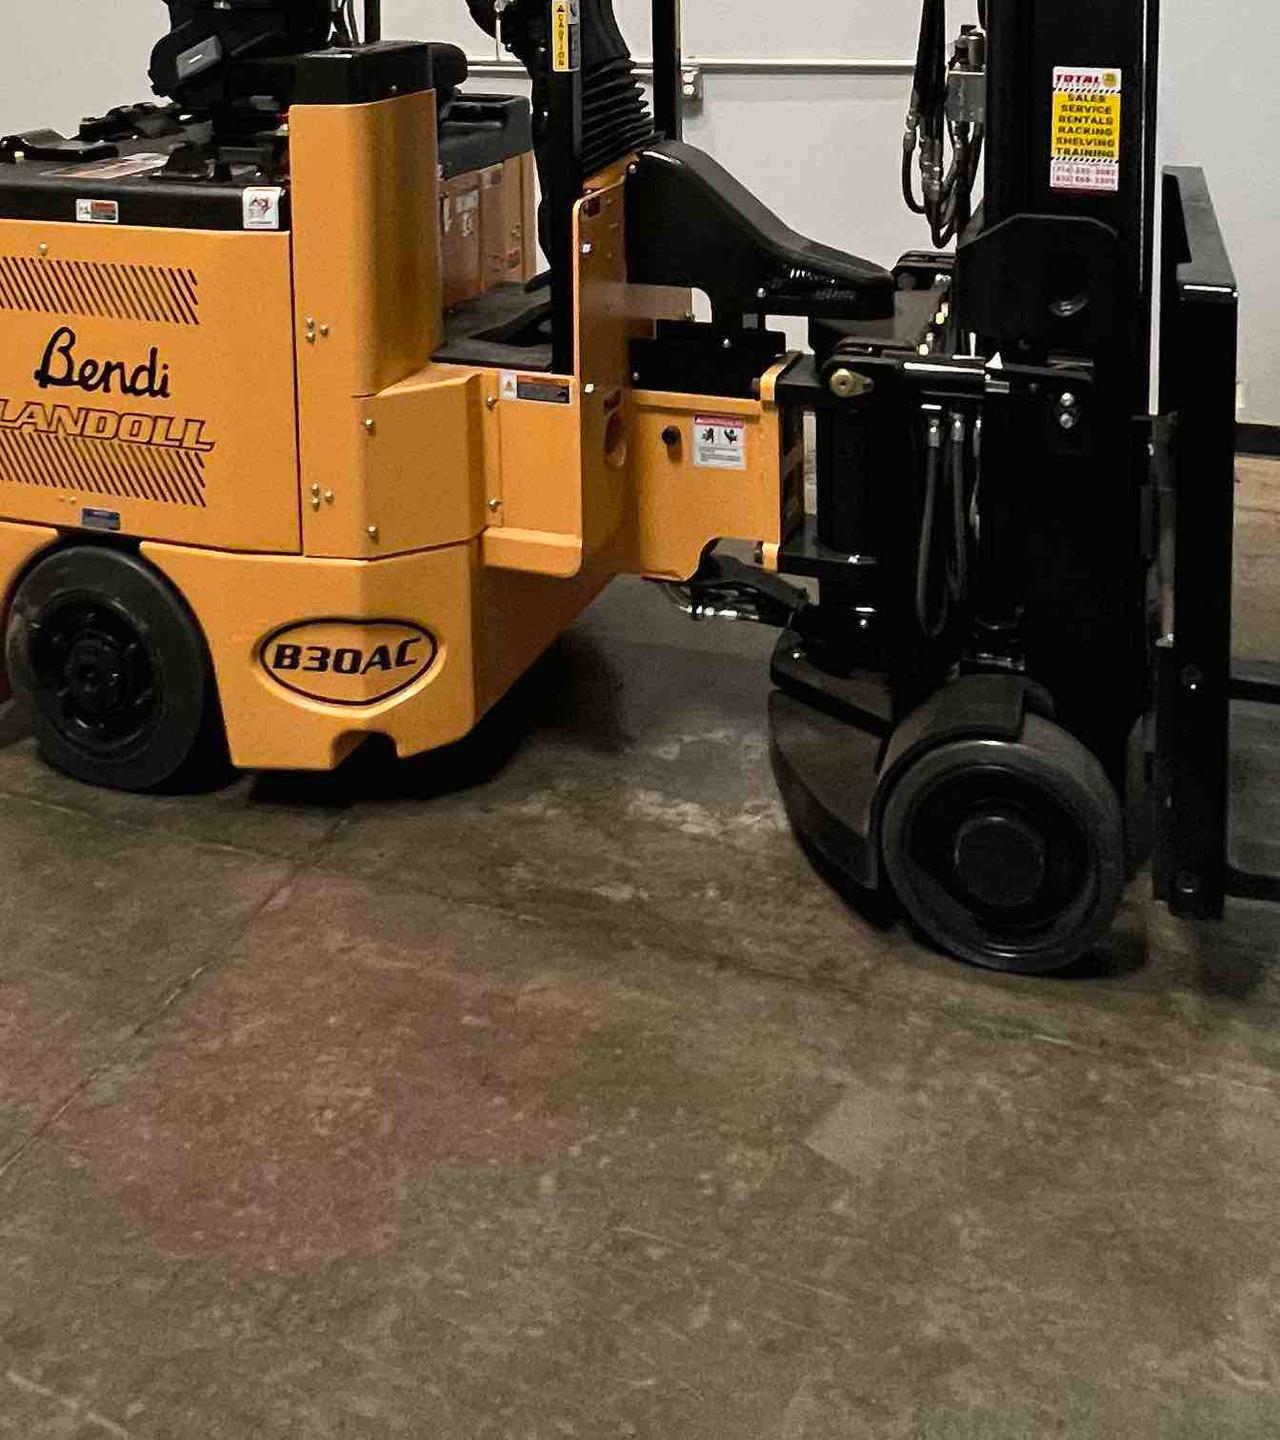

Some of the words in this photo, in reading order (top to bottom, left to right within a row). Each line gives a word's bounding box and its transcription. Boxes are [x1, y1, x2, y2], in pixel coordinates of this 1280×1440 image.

[1055, 74, 1100, 84] TOTAL
[1067, 94, 1106, 103] SALES
[1061, 104, 1112, 114] SERVICE
[1058, 115, 1114, 125] RENTALS
[1057, 126, 1113, 136] RACKING
[1056, 136, 1115, 147] SHELVING
[1056, 147, 1115, 158] TRAINING
[34, 326, 170, 398] Bendi
[273, 638, 420, 675] B30AC
